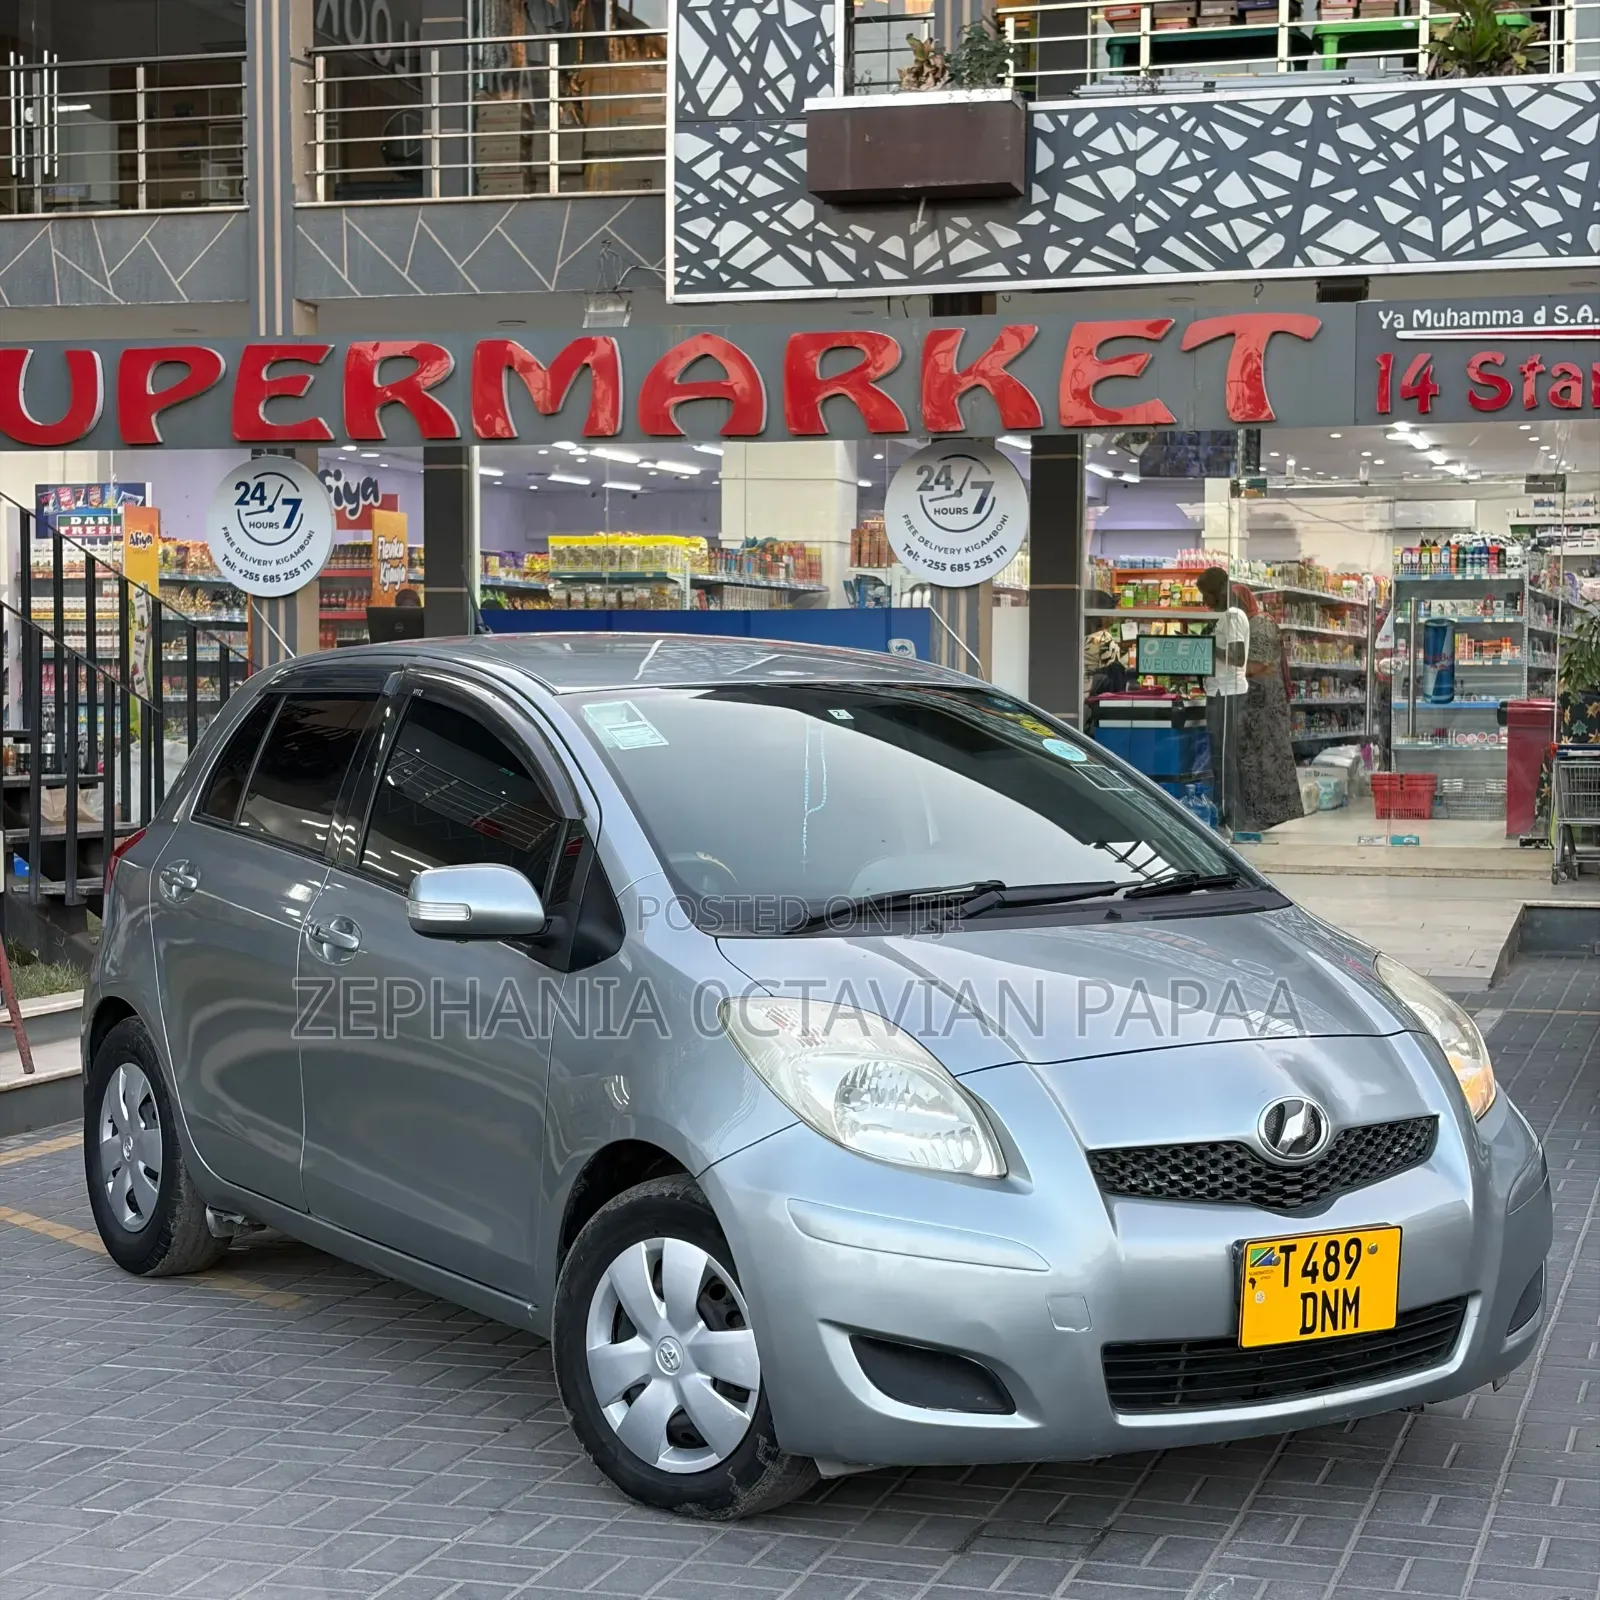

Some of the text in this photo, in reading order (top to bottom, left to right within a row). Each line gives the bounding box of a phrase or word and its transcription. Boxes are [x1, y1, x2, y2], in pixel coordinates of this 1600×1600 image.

[1378, 310, 1404, 329] Ya
[1376, 351, 1600, 414] 14 Sta
[70, 516, 109, 525] DAR
[934, 507, 968, 515] HOURS
[59, 526, 122, 535] FRESH
[249, 521, 279, 530] HOURS
[902, 514, 1009, 555] FREE DELIVERY KIGAMBONI
[221, 526, 315, 567] FREE DELIVERY KIGAMBONI
[902, 543, 920, 562] Tel:
[922, 558, 947, 572] +255
[950, 562, 971, 573] 685
[974, 557, 993, 570] 255
[221, 554, 237, 572] Tel:
[239, 569, 260, 582] +255
[262, 575, 281, 583] 685
[283, 567, 300, 581] 255
[1143, 640, 1208, 655] OPEN
[1141, 659, 1210, 672] WELCOME
[1279, 1237, 1362, 1287] T 489
[1299, 1286, 1360, 1335] DNM
